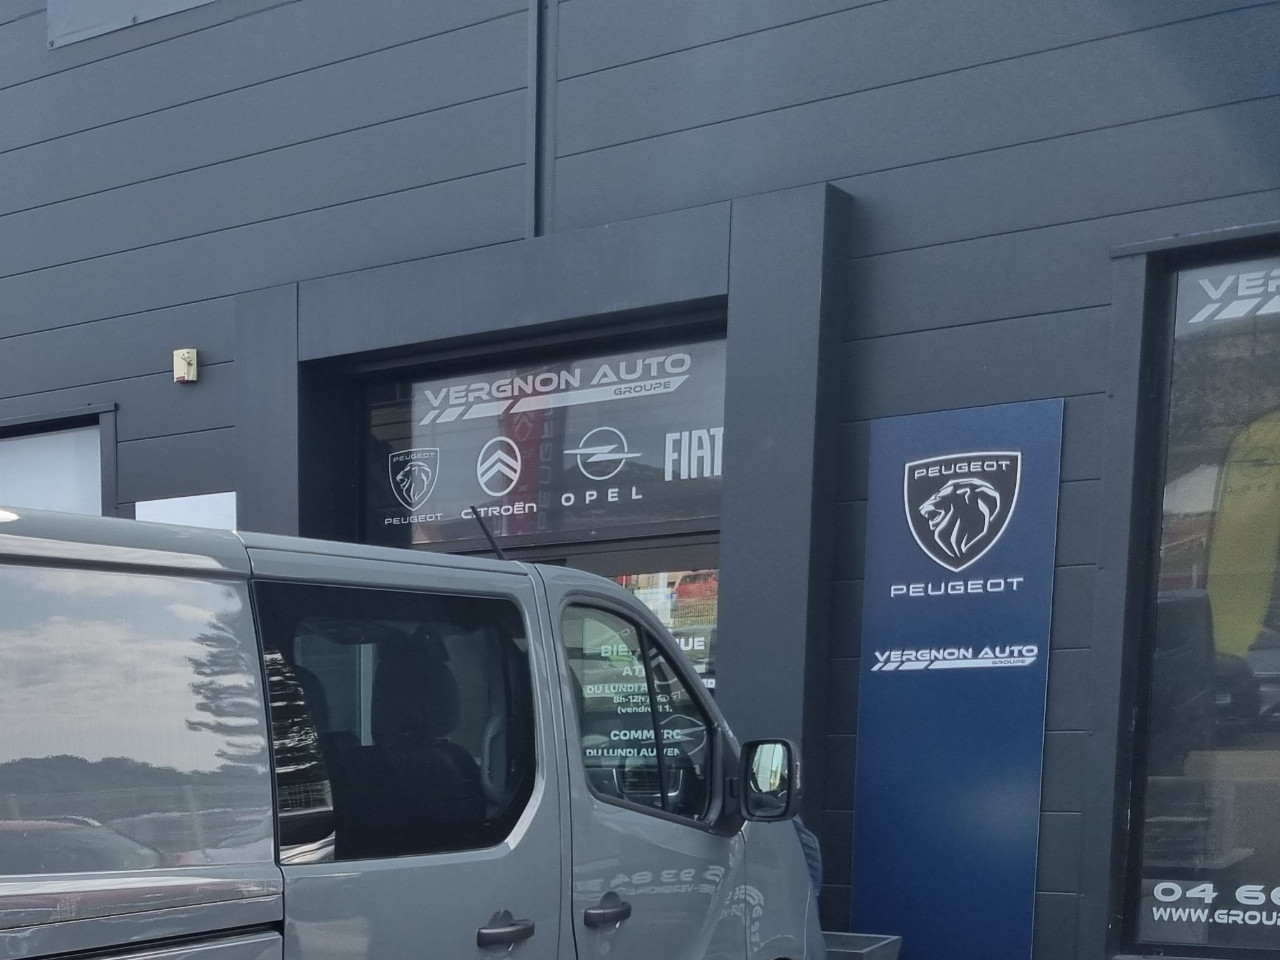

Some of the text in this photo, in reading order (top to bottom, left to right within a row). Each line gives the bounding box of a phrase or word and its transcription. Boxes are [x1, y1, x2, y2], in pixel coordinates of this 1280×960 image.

[423, 353, 692, 408] VERGNON AUTO
[613, 380, 672, 396] GROUPE
[392, 452, 436, 463] PEUGEOT
[664, 427, 724, 482] FIAT
[914, 460, 1011, 480] PEUGEOT
[561, 486, 643, 507] OPEL
[384, 513, 443, 525] PEUGEOT
[890, 577, 1024, 598] PEUGEOT
[874, 645, 1038, 662] VERGNON AUTO
[586, 685, 603, 694] DU
[604, 684, 638, 693] LUNDI
[586, 748, 602, 757] DU
[604, 748, 638, 757] LUNDI
[640, 747, 657, 757] AU
[1152, 882, 1218, 904] 04
[1152, 906, 1280, 926] WWW.GROU
